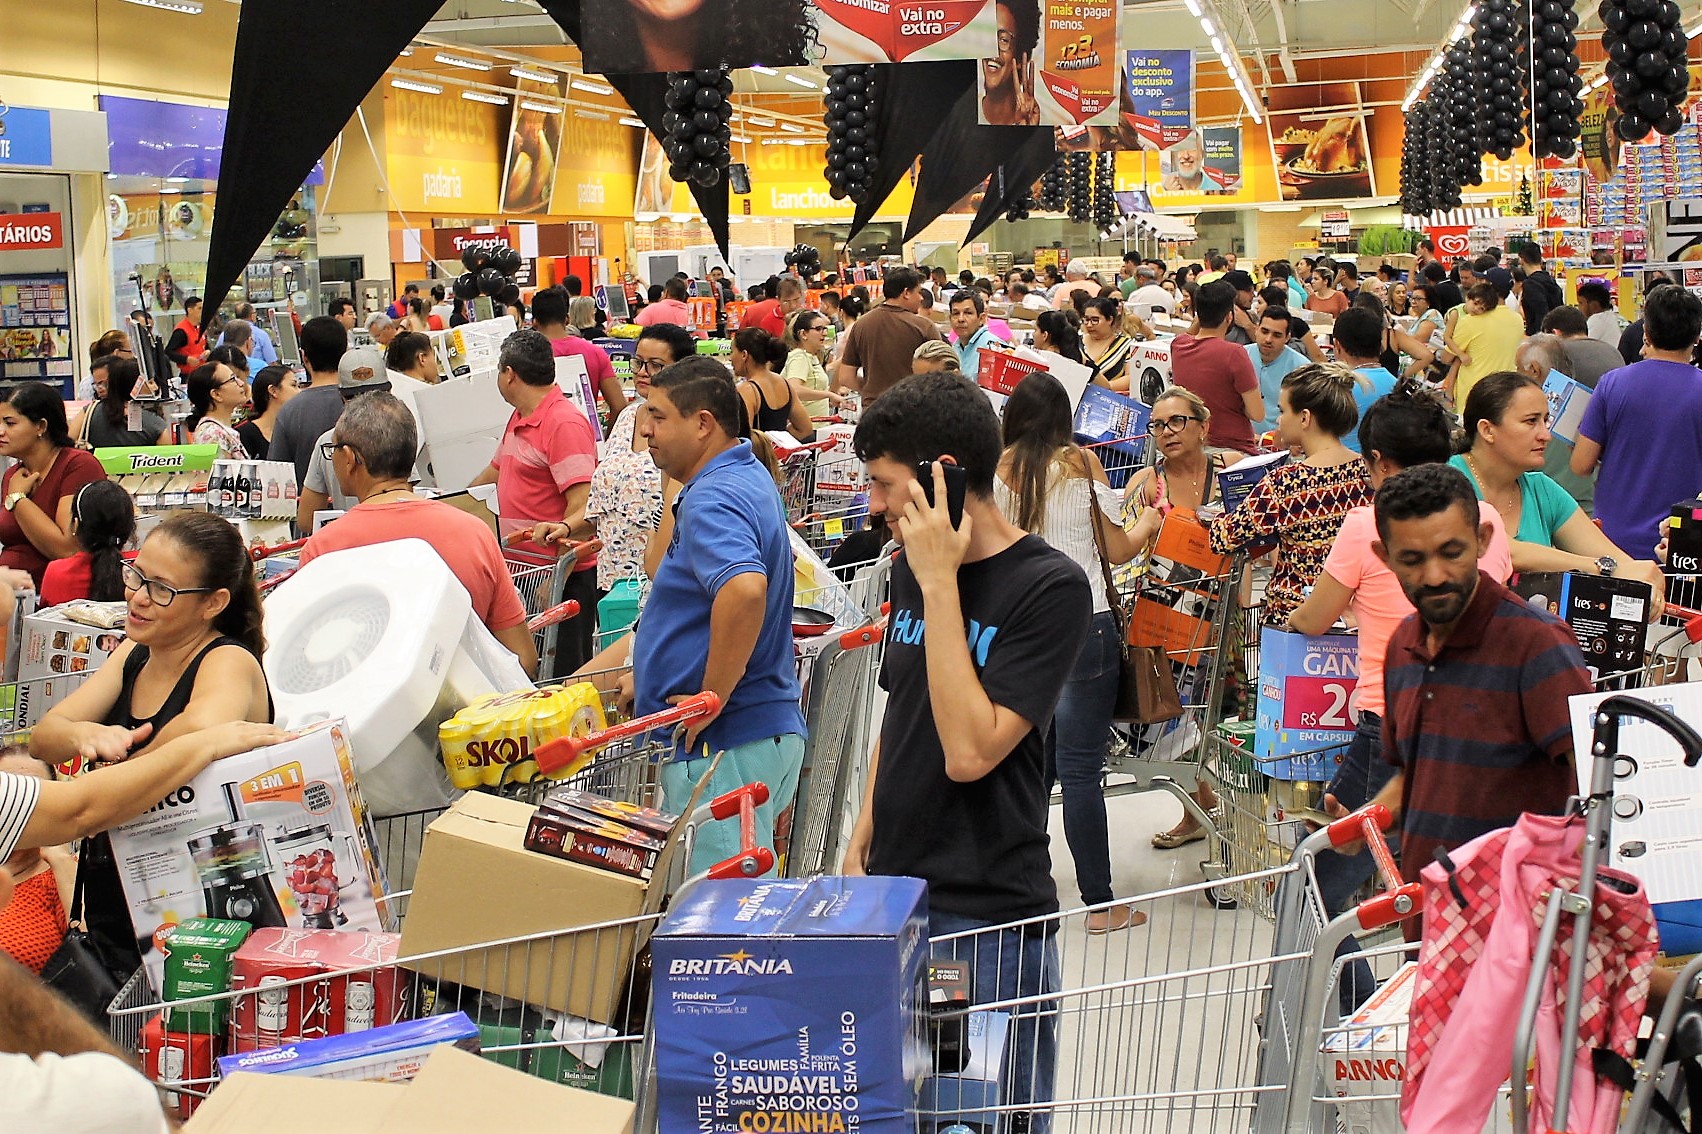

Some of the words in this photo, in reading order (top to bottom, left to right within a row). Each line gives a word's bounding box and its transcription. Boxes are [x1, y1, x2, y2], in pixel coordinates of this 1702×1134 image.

[900, 8, 923, 22] Vai
[926, 9, 945, 21] no
[1050, 3, 1074, 16] mais
[1075, 6, 1082, 17] e
[1083, 6, 1113, 20] pagar
[901, 22, 943, 35] extra
[1049, 20, 1085, 31] menos.
[1055, 54, 1102, 71] ECONOMIA
[1132, 57, 1146, 67] Vai
[1132, 67, 1173, 76] desconto
[1132, 77, 1174, 87] exclusivo
[1132, 87, 1144, 96] do
[1145, 89, 1165, 98] app.
[1081, 98, 1091, 106] Vai
[1081, 105, 1098, 113] extra
[423, 168, 462, 204] padaria
[577, 178, 605, 207] padaria
[1144, 350, 1169, 362] ARNO
[128, 453, 184, 470] Trident
[1672, 552, 1699, 571] tres
[1574, 596, 1592, 610] tres
[1322, 646, 1351, 654] MÁQUINA
[18, 684, 31, 727] ONDIAL
[1301, 711, 1317, 728] R$
[1299, 731, 1314, 742] EM
[466, 736, 531, 768] SKOL
[251, 780, 259, 792] 3
[261, 773, 284, 790] EM
[288, 768, 299, 783] 1
[304, 784, 326, 796] DIVERSAS
[310, 800, 332, 812] PRODUTO
[734, 884, 774, 922] BRITANIA
[183, 960, 211, 969] Heineken
[669, 958, 794, 976] BRITANIA
[672, 991, 718, 1001] Fritadeira
[840, 1010, 856, 1057] ÓLEO
[798, 1025, 810, 1070] FAMÍLIA
[811, 1054, 840, 1062] POLENTA
[730, 1059, 799, 1072] LEGUMES
[811, 1061, 841, 1072] FRITA
[1335, 1058, 1406, 1081] ARNO
[731, 1071, 842, 1094] SAUDÁVEL
[843, 1060, 858, 1093] SEM
[714, 1051, 729, 1118] FRANGO
[756, 1095, 859, 1111] SABOROSO
[715, 1122, 740, 1132] FÁCIL
[739, 1111, 846, 1134] COZINHA
